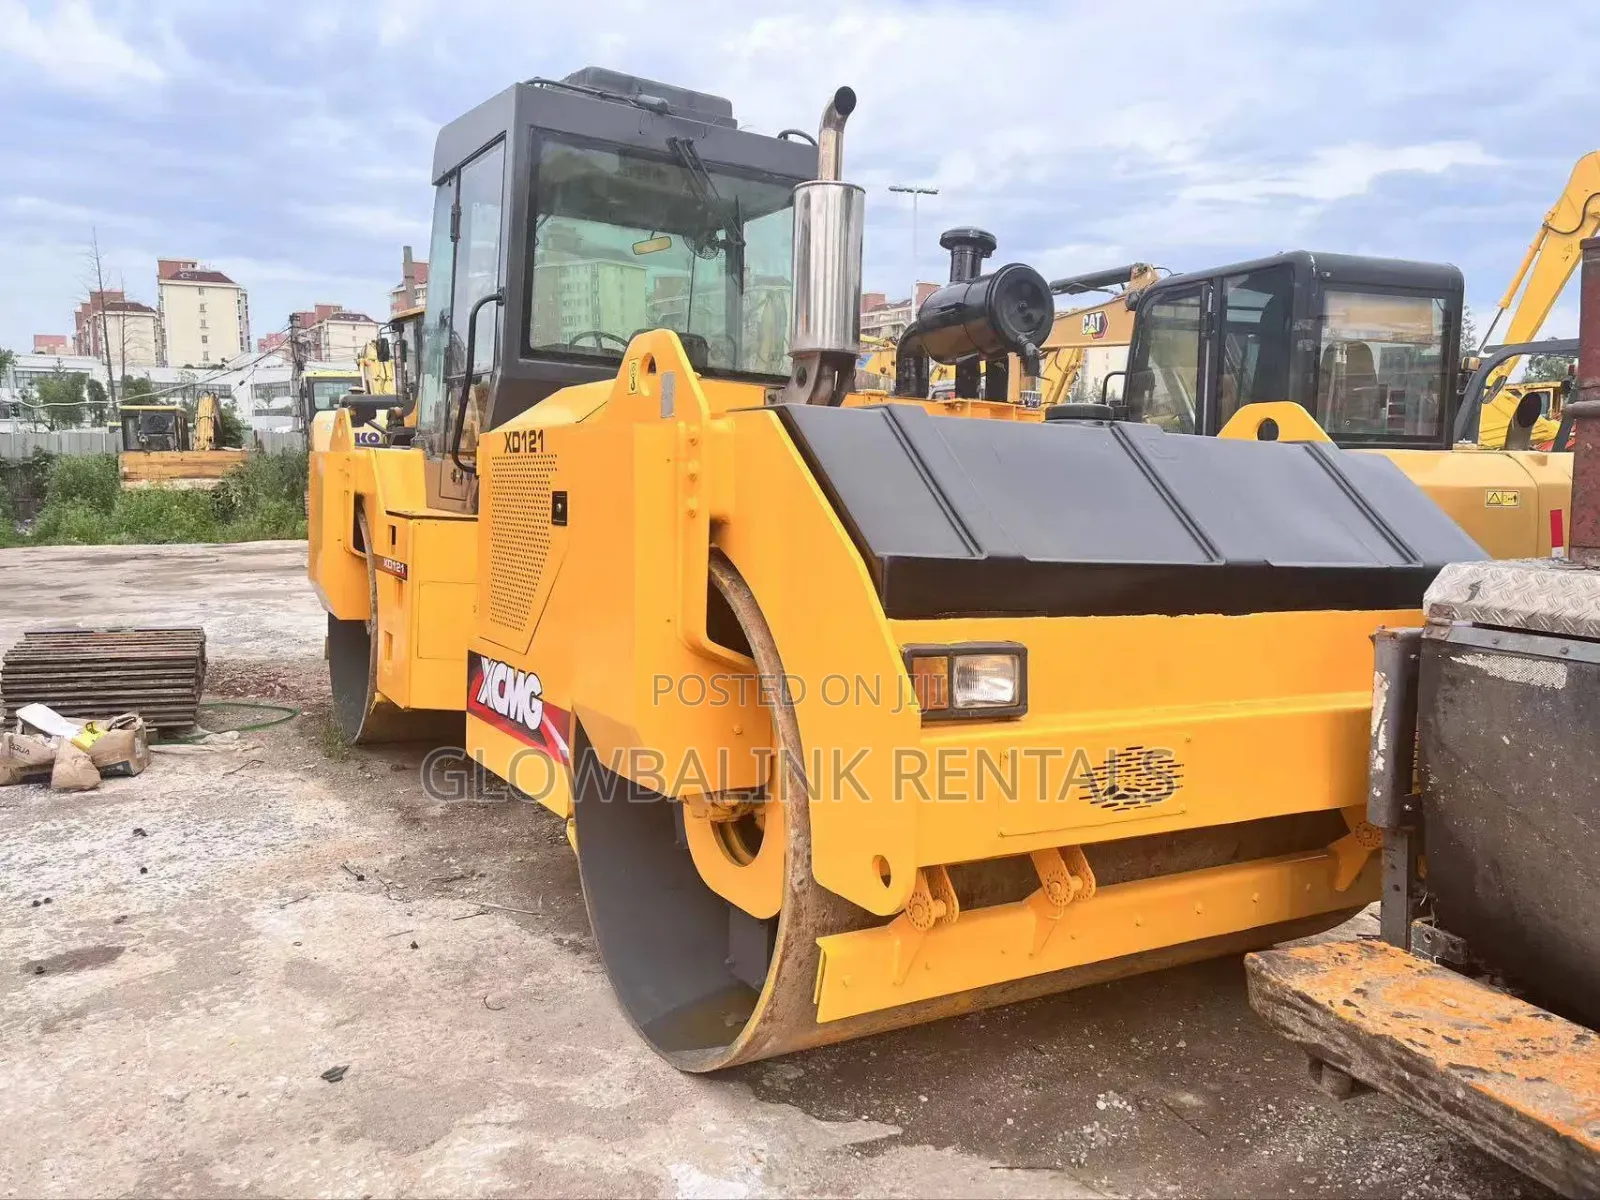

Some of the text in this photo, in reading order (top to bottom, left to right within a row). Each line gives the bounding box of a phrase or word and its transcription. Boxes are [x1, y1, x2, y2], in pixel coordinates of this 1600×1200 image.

[1082, 312, 1102, 335] CAT
[503, 429, 544, 454] XD121
[383, 558, 405, 574] XD121
[476, 656, 543, 730] XCMG
